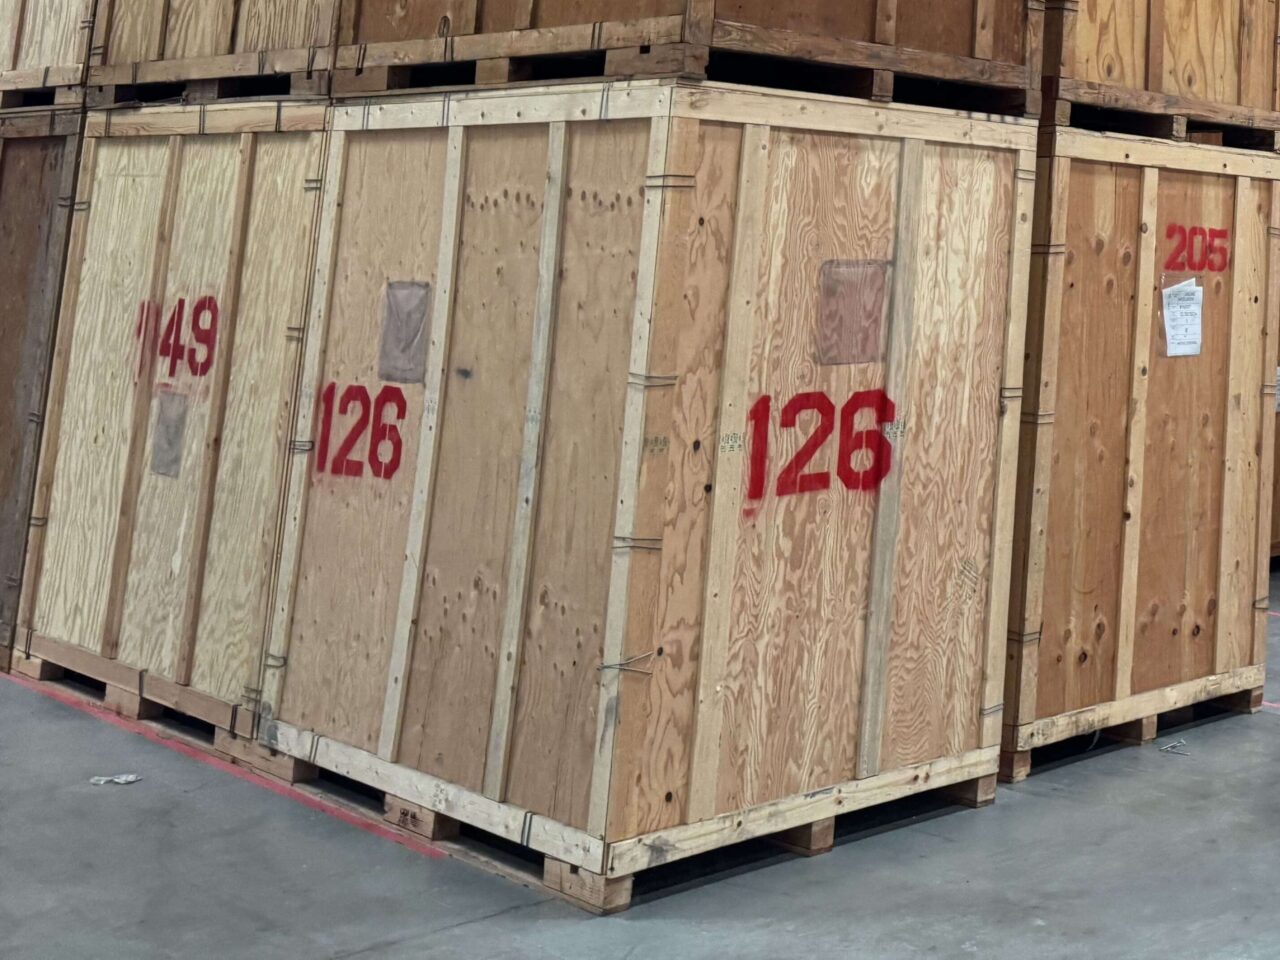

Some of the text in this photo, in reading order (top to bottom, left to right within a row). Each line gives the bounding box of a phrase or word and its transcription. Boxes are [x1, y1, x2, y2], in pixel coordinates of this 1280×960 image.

[1164, 224, 1229, 272] 205
[136, 296, 218, 377] 149
[317, 382, 406, 480] 126
[747, 388, 895, 500] 126
